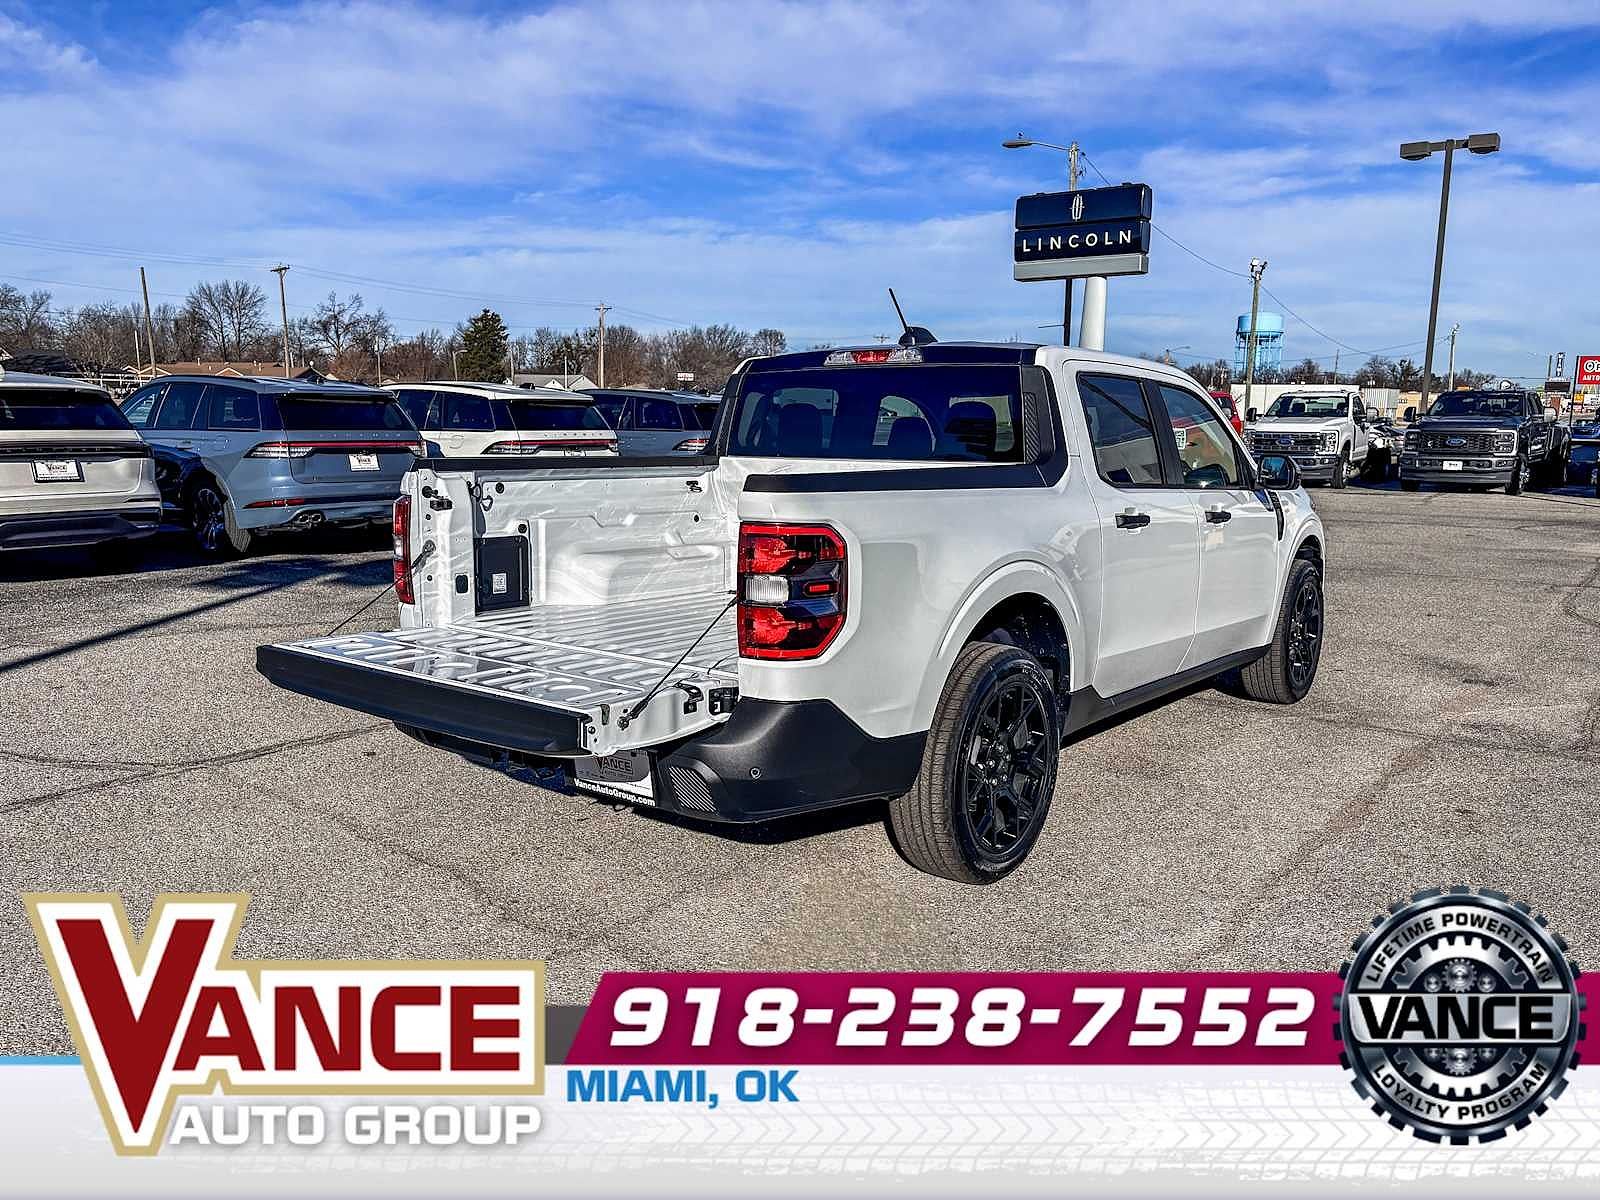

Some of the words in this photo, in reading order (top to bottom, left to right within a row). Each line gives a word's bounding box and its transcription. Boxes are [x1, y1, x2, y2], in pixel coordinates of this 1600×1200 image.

[1022, 229, 1132, 253] LINCOLN
[594, 755, 633, 771] VANCE
[573, 777, 656, 807] VanceAutoGroup.com
